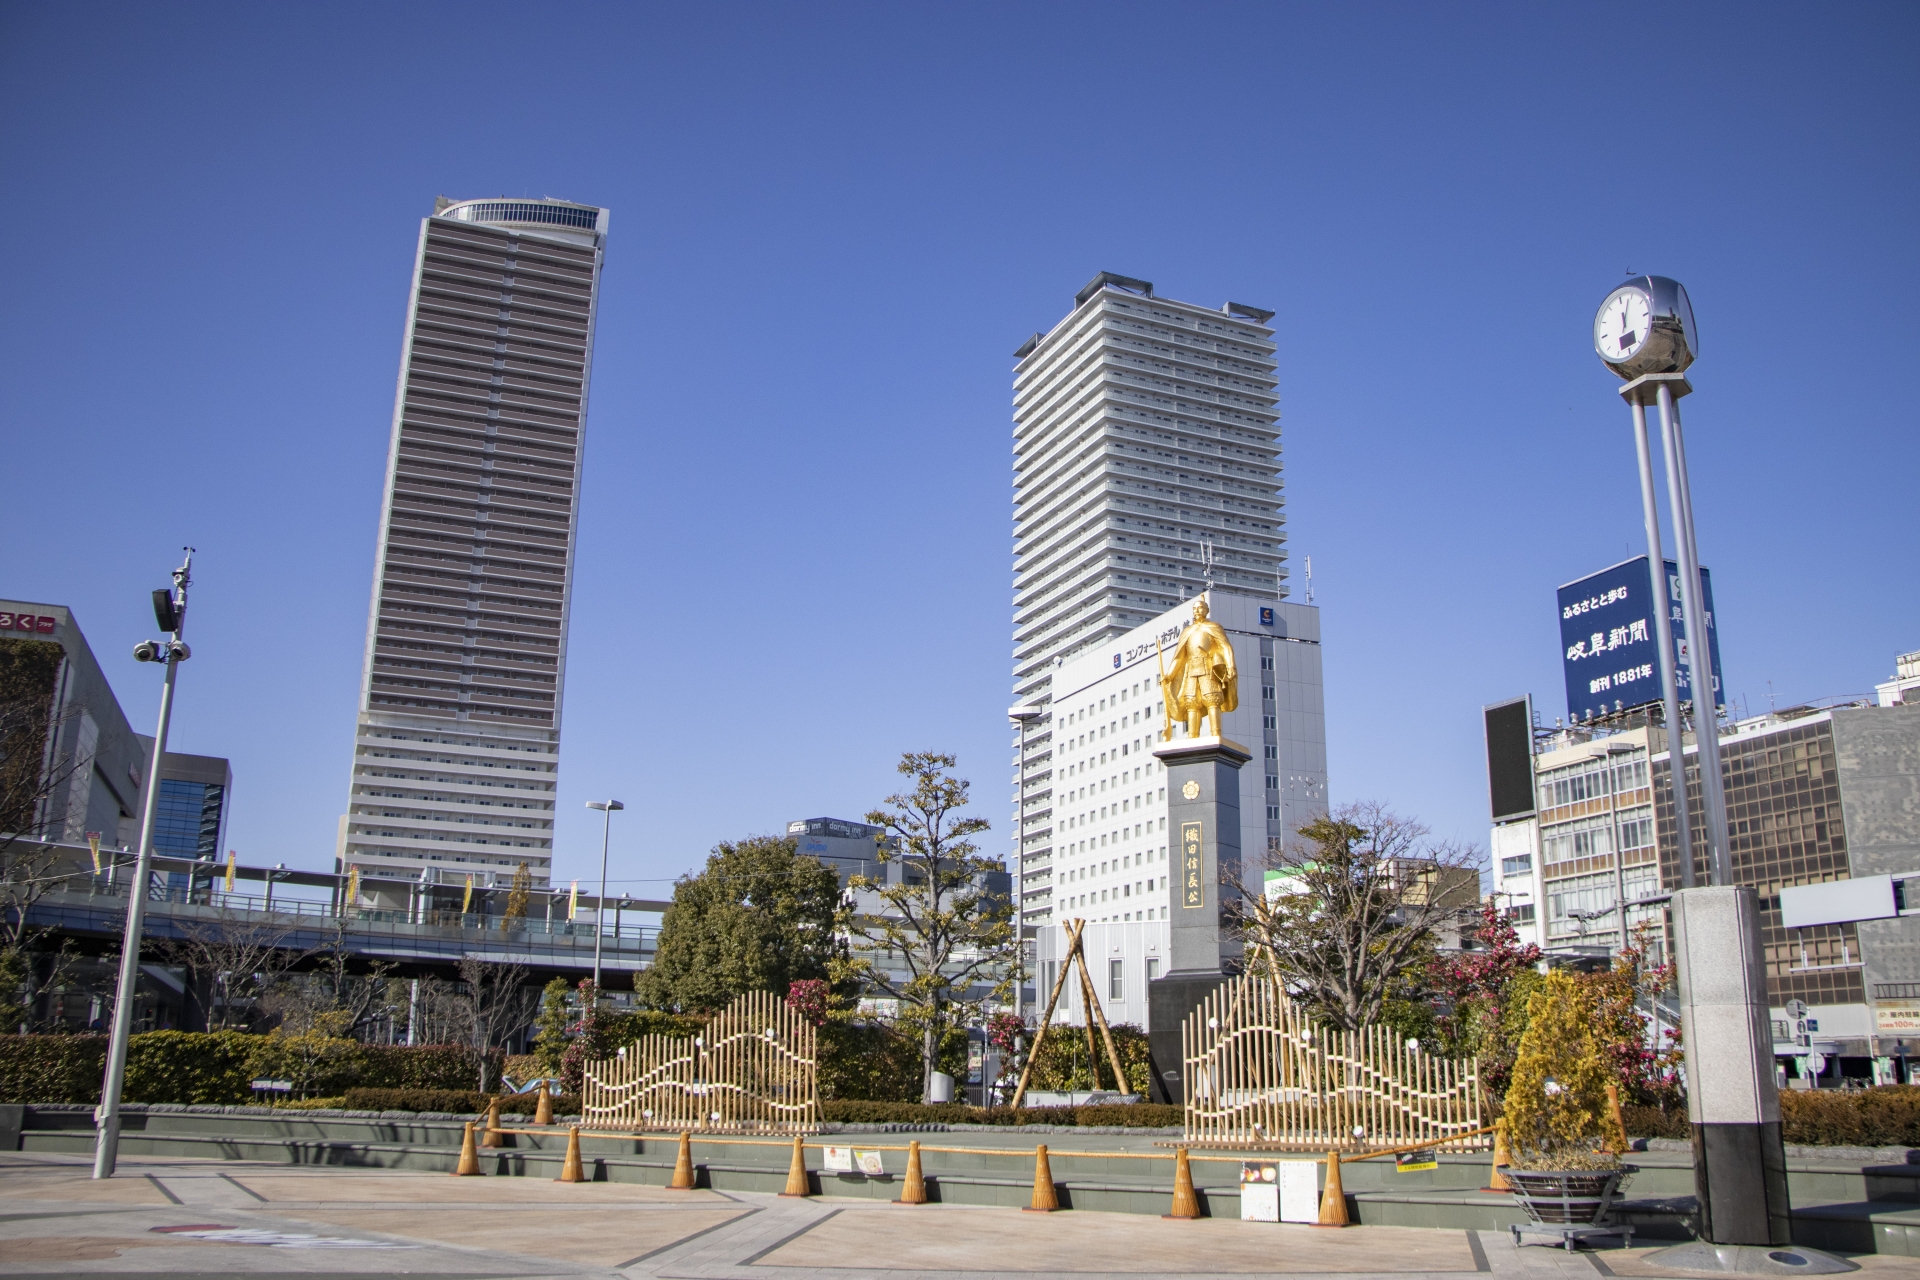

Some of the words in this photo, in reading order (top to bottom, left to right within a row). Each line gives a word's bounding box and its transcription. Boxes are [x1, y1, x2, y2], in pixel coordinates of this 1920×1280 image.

[1563, 586, 1627, 618] ふるさとと歩む
[1566, 618, 1649, 661] 岐阜新聞
[1589, 675, 1610, 693] 創刊
[1612, 664, 1653, 686] 1881年
[789, 822, 810, 834] dormy
[811, 822, 822, 830] inn
[829, 821, 850, 835] dormy
[851, 827, 861, 835] inn
[1185, 827, 1199, 903] 織田信長公
